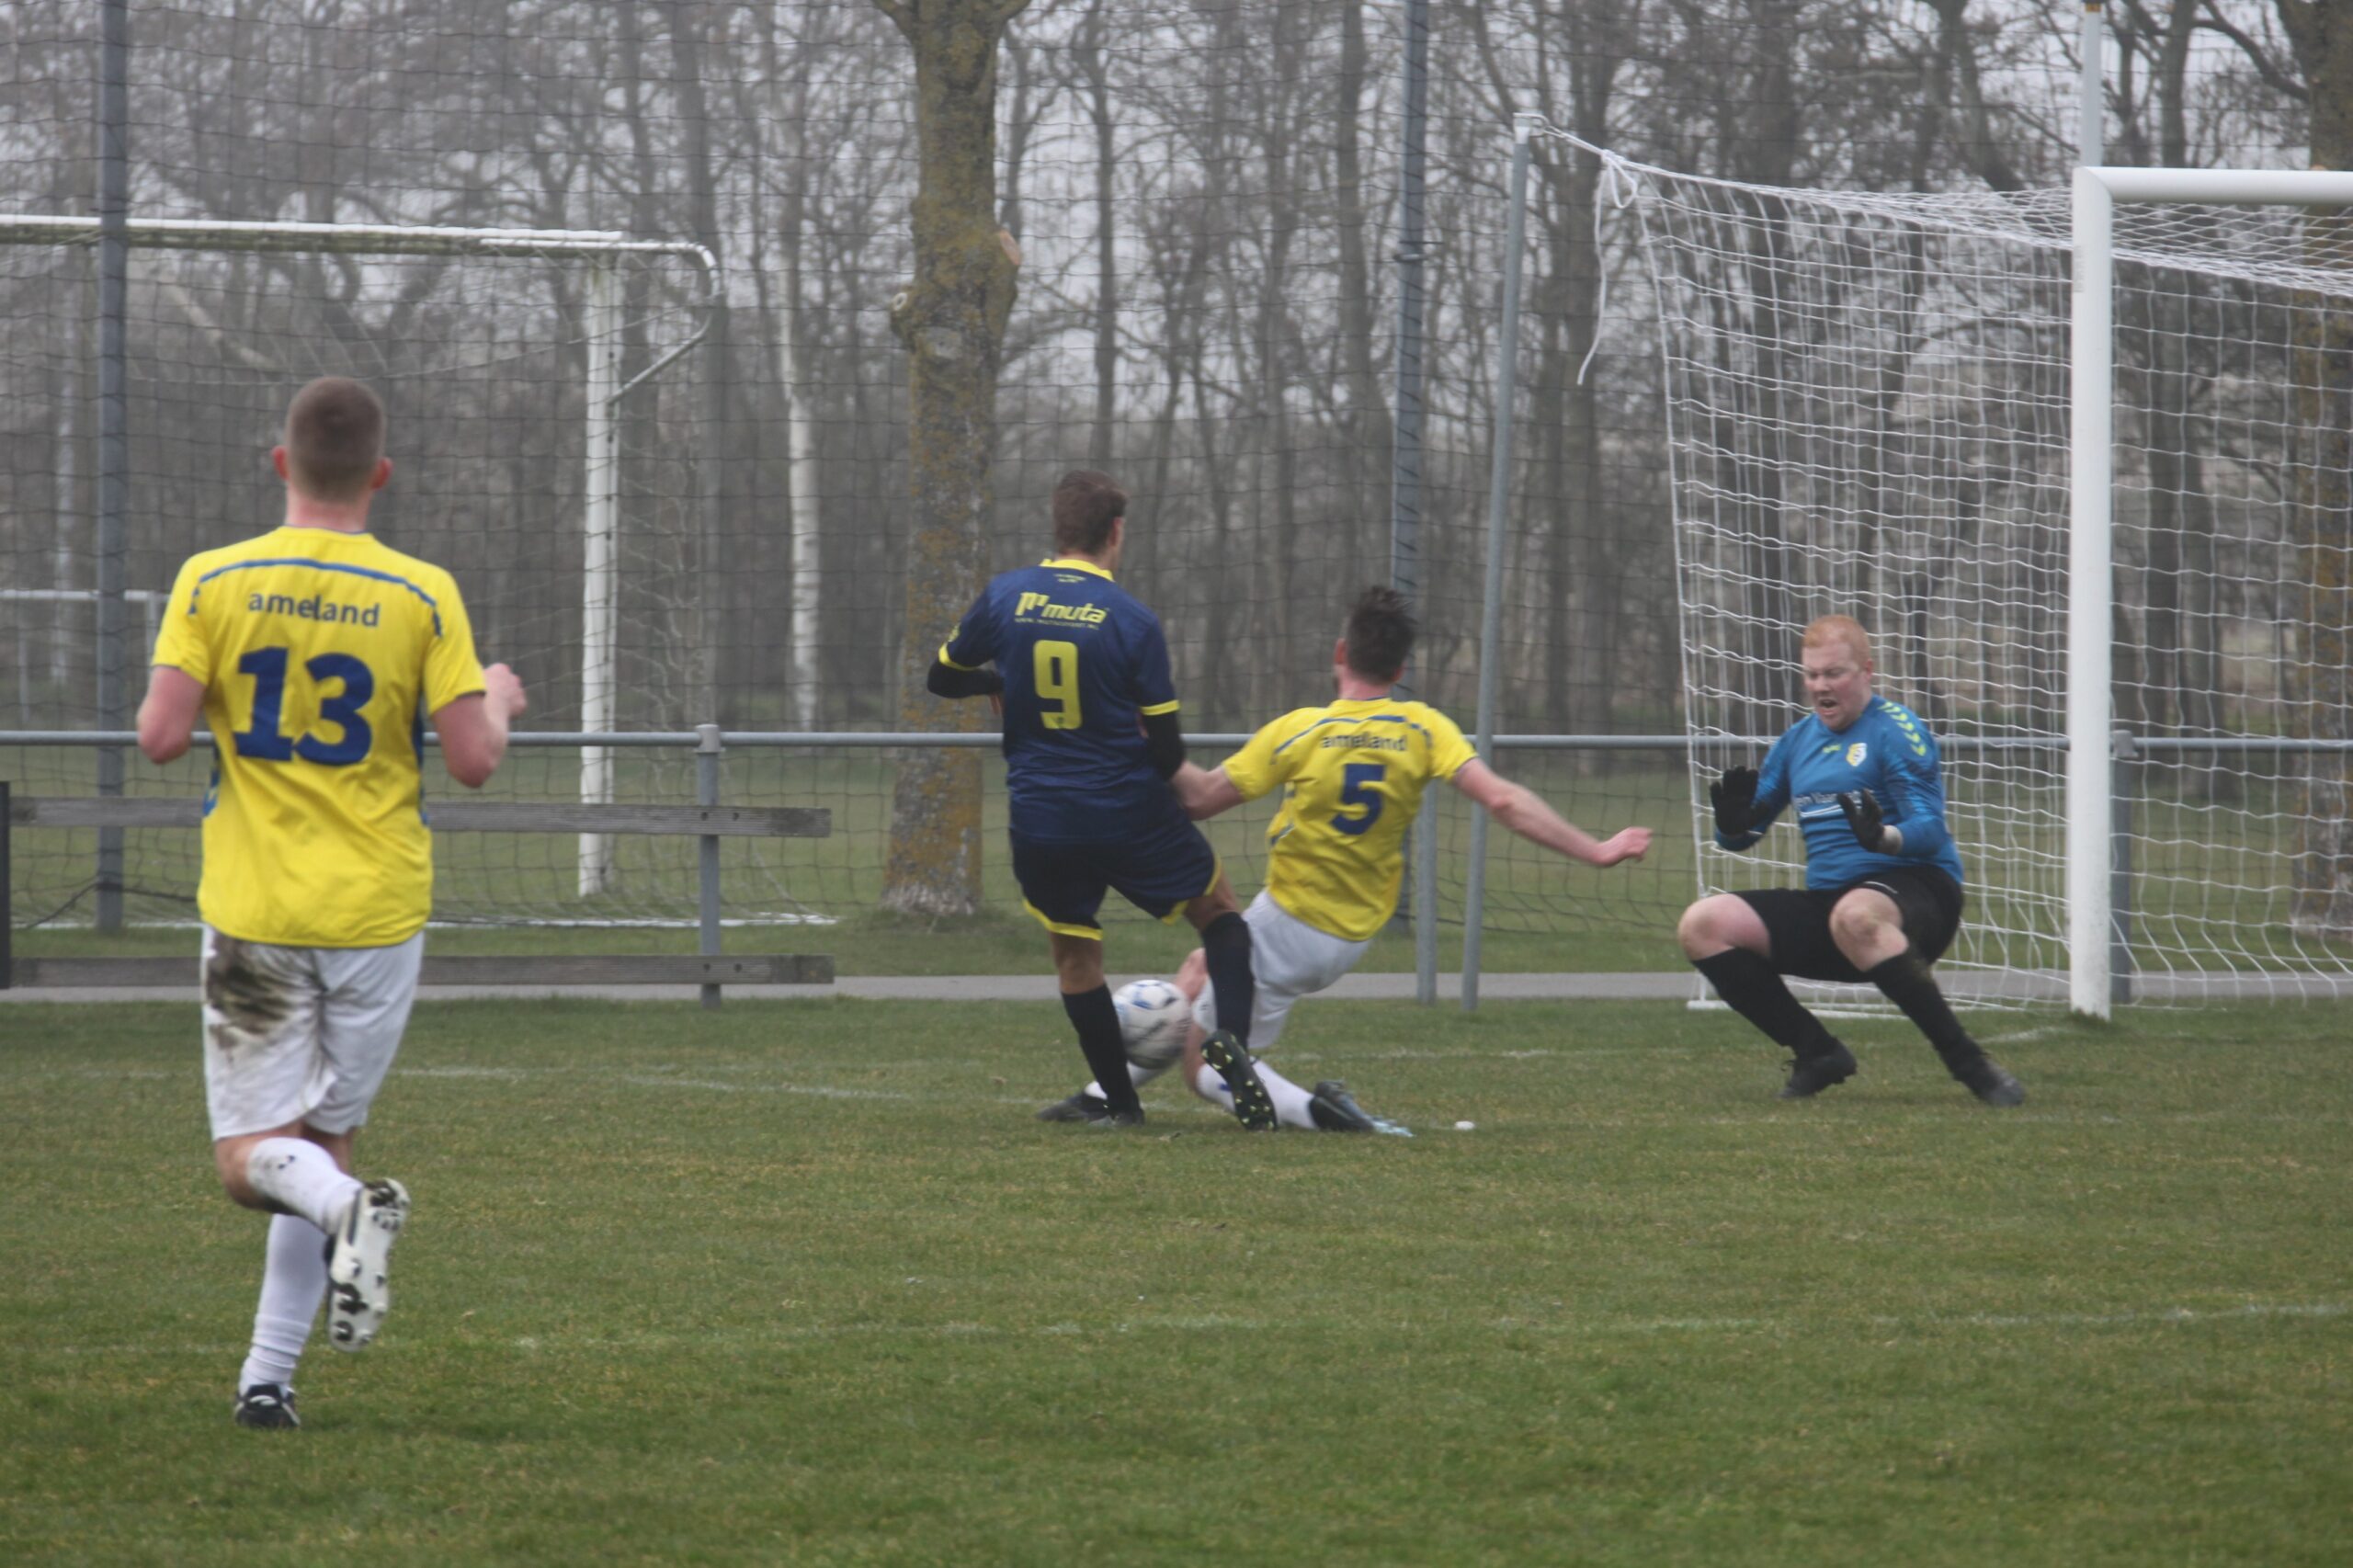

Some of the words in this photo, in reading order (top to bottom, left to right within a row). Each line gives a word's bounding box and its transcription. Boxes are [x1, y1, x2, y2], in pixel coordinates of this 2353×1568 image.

[247, 593, 381, 627] ameland
[233, 646, 375, 767] 13
[1033, 639, 1083, 730] 9
[1322, 731, 1407, 752] ameland
[1330, 763, 1387, 835] 5
